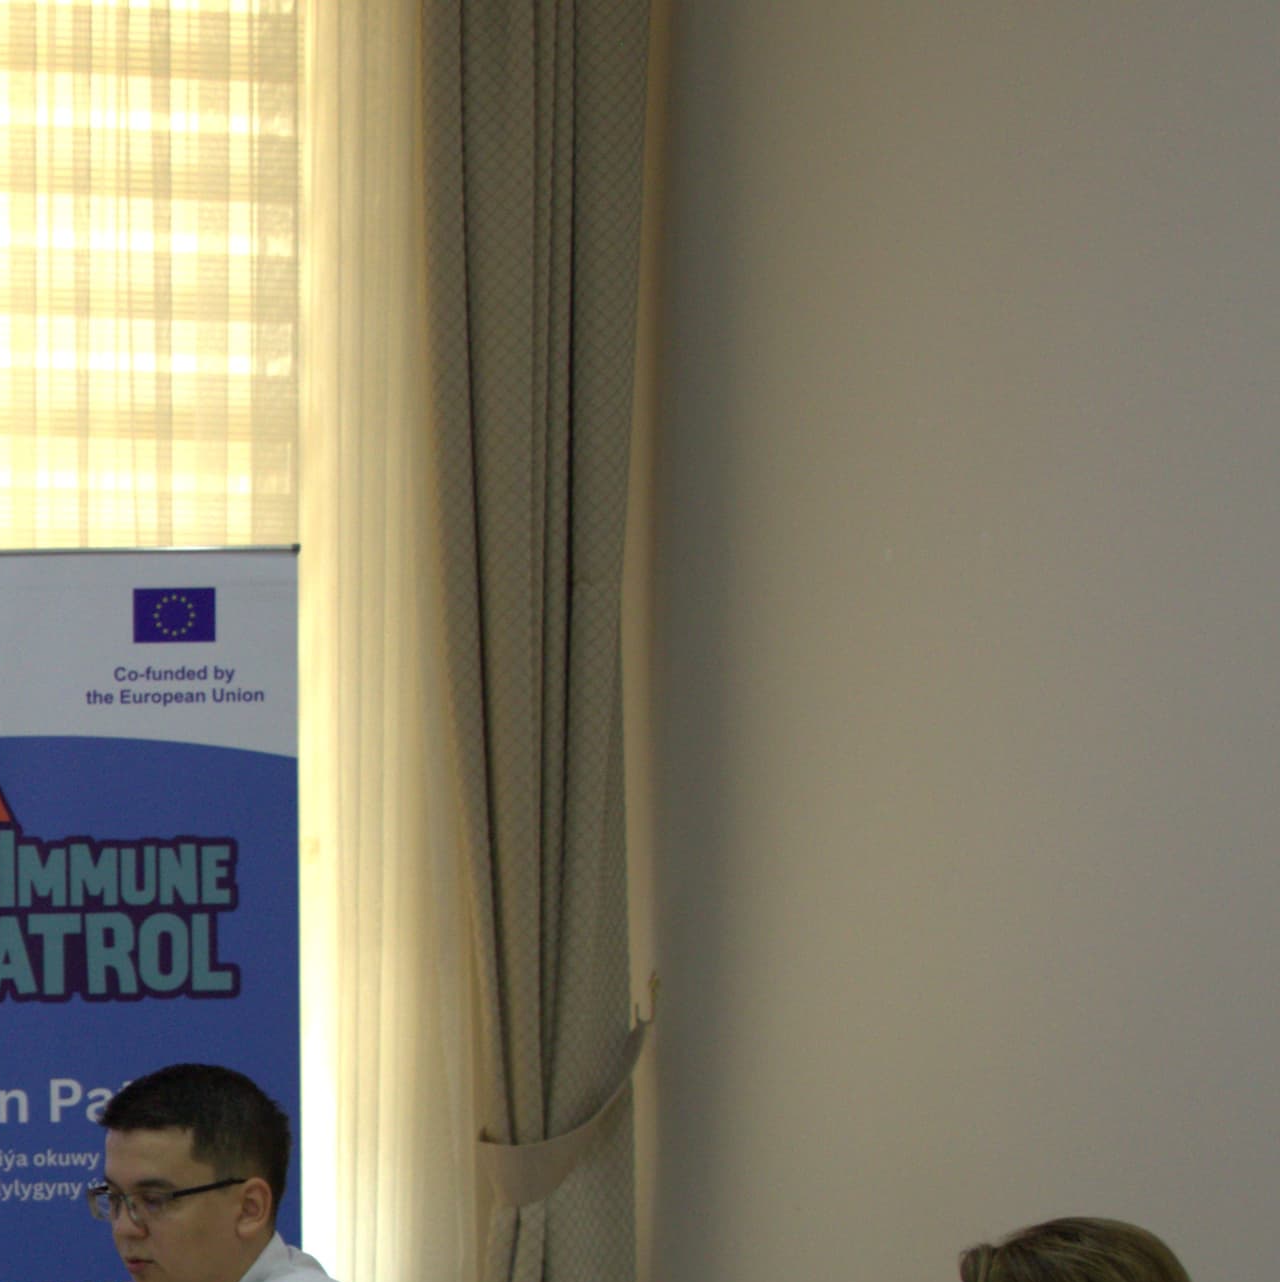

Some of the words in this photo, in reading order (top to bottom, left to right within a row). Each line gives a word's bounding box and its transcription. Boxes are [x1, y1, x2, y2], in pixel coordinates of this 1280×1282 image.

[114, 665, 208, 683] Co-funded
[213, 665, 236, 684] by
[86, 688, 114, 705] the
[119, 688, 207, 707] European
[212, 687, 265, 704] Union
[33, 1150, 100, 1171] okuwy
